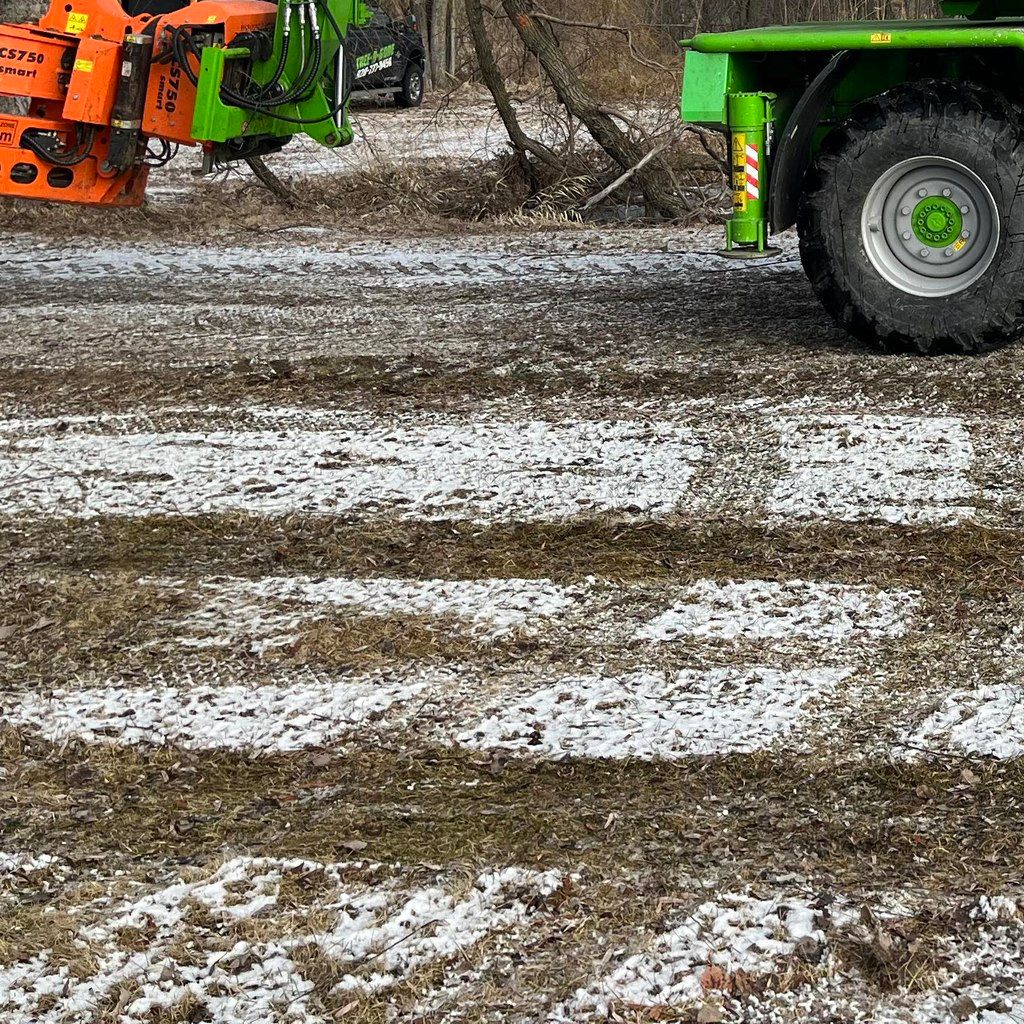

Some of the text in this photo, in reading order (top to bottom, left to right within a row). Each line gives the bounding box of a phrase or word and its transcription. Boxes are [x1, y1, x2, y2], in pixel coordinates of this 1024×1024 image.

[0, 47, 45, 64] CS750
[0, 65, 38, 78] smart
[155, 74, 166, 110] smart
